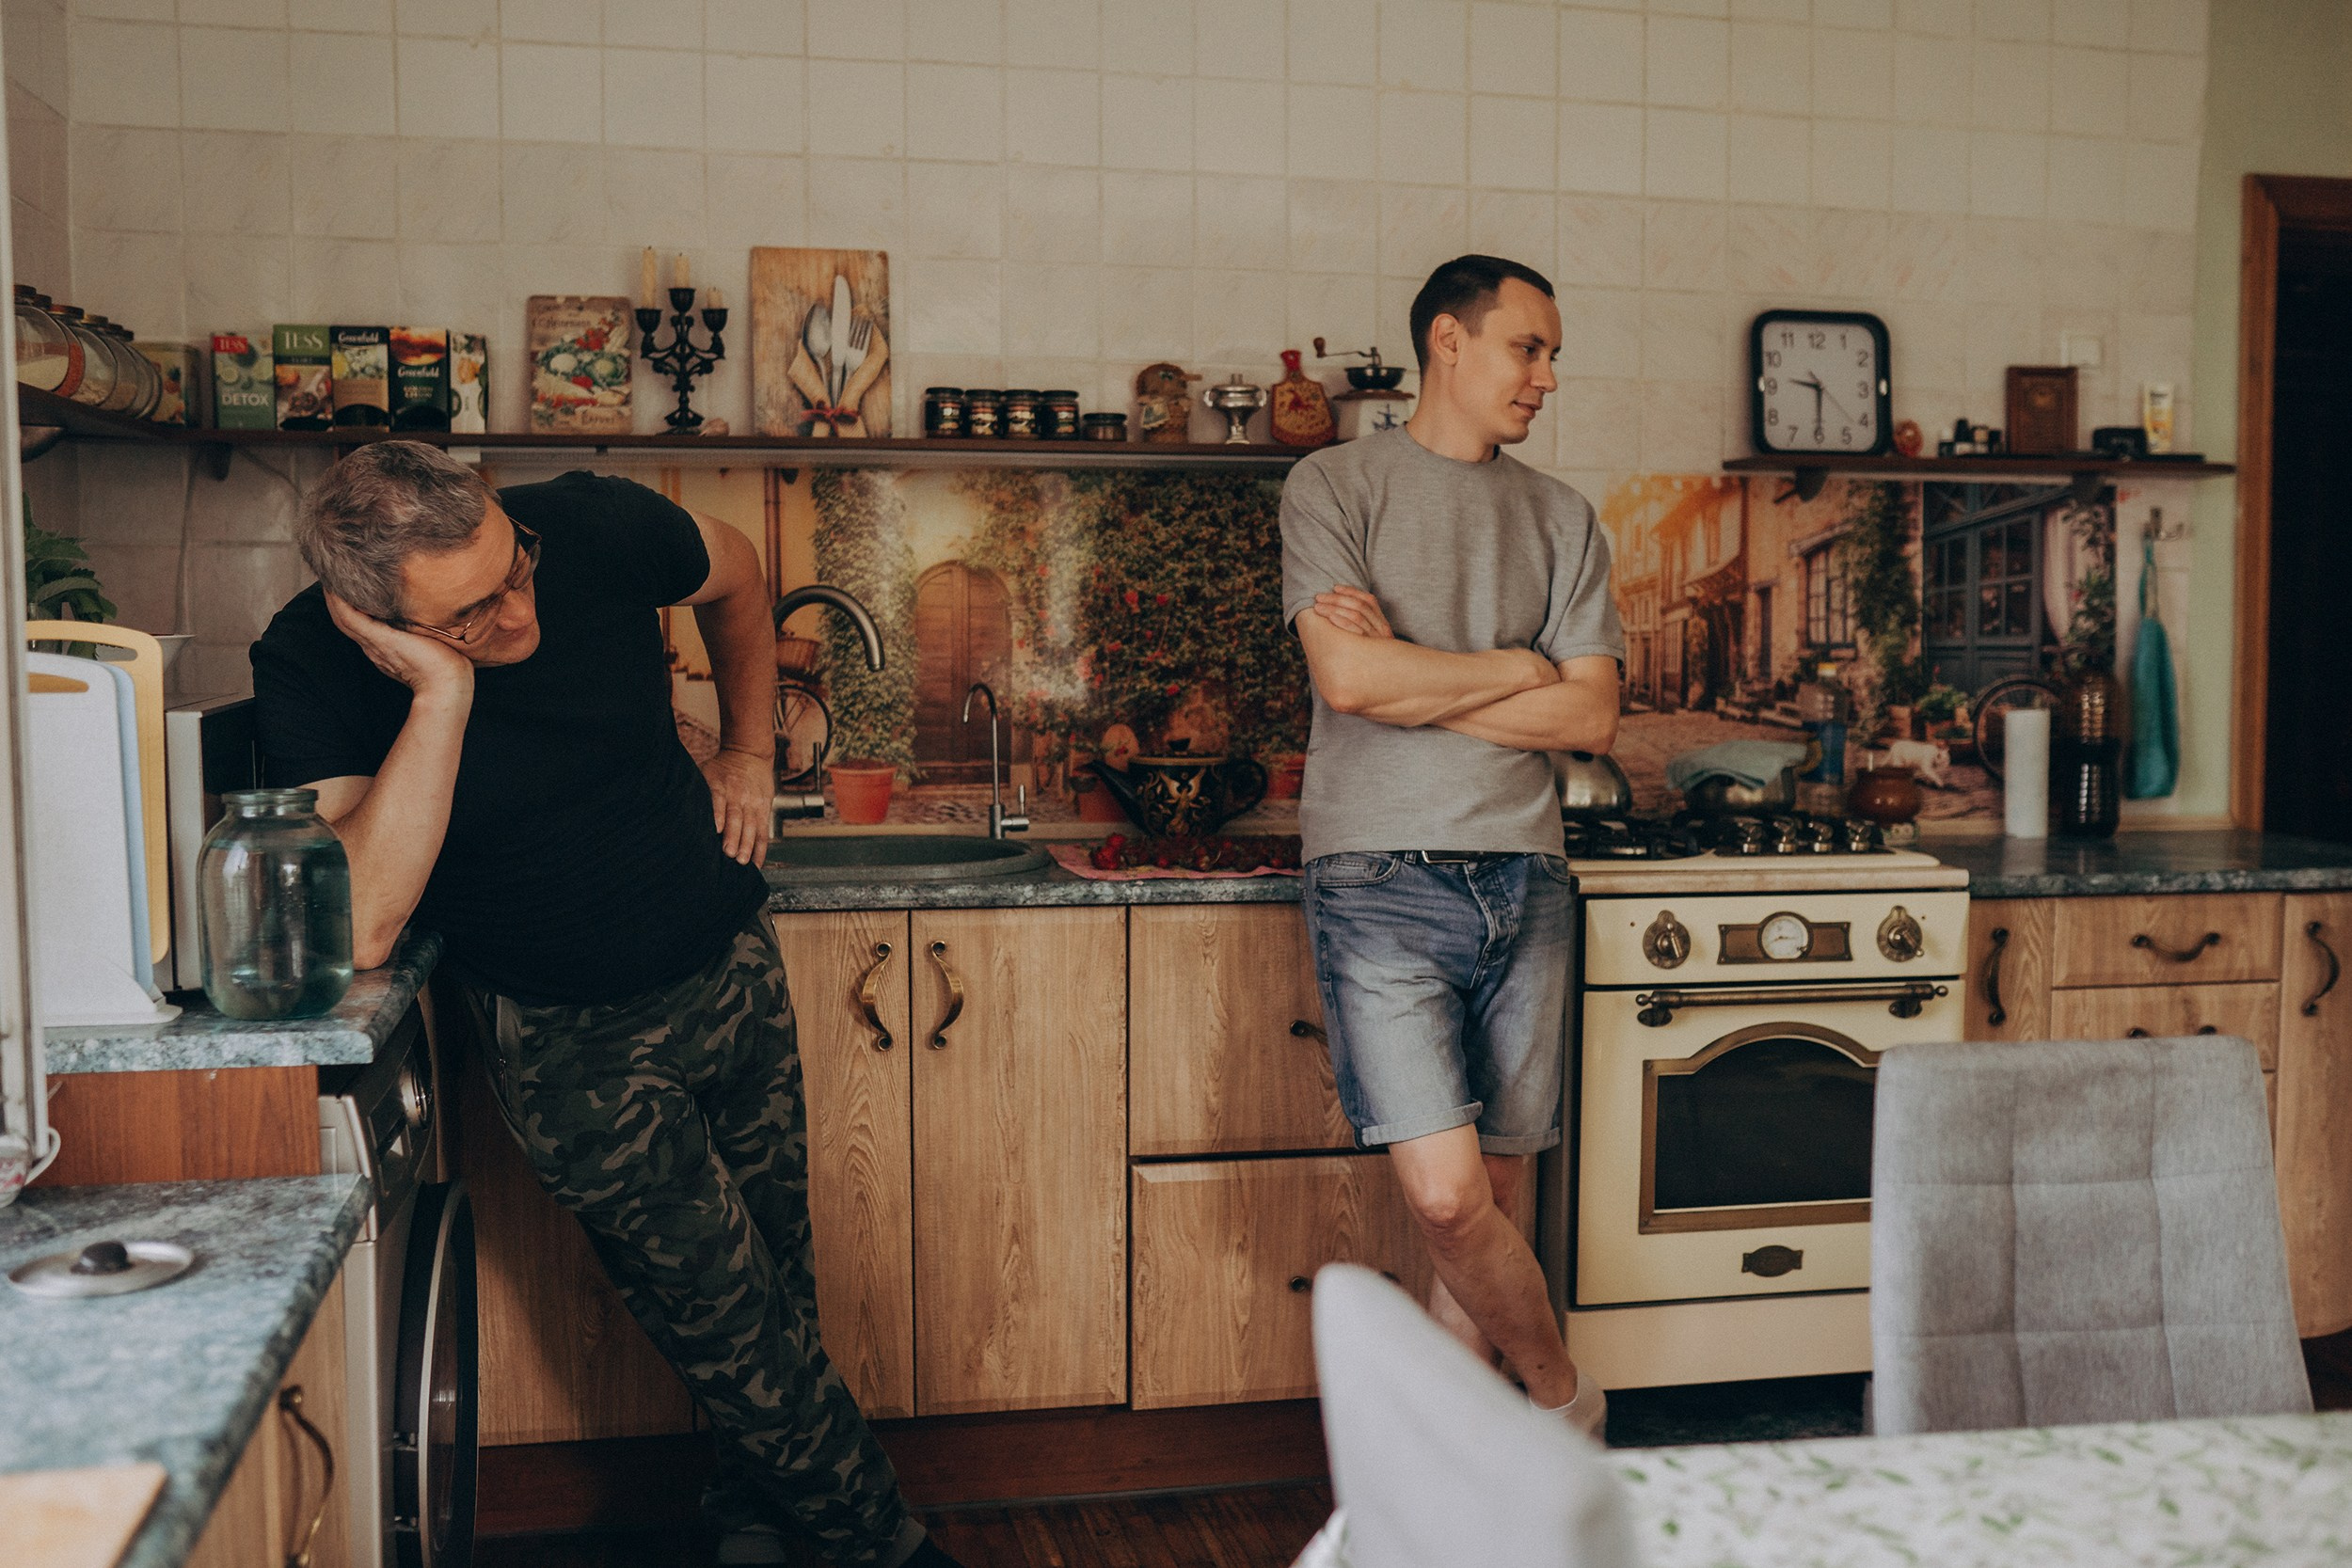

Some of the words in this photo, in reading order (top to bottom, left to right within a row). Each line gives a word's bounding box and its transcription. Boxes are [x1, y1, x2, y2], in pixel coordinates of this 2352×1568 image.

[338, 331, 379, 342] Greenfield
[1781, 332, 1794, 347] 11
[1808, 333, 1826, 350] 12
[1841, 334, 1847, 350] 1
[1766, 350, 1782, 368] 10
[1858, 350, 1868, 367] 2
[398, 366, 440, 378] Greenfield
[1766, 378, 1777, 395] 9
[1858, 383, 1868, 399] 3
[222, 392, 269, 406] DETOX
[1768, 408, 1779, 426] 8
[1860, 413, 1868, 428] 4
[1788, 425, 1798, 442] 7
[1814, 426, 1825, 444] 6
[1842, 427, 1852, 444] 5
